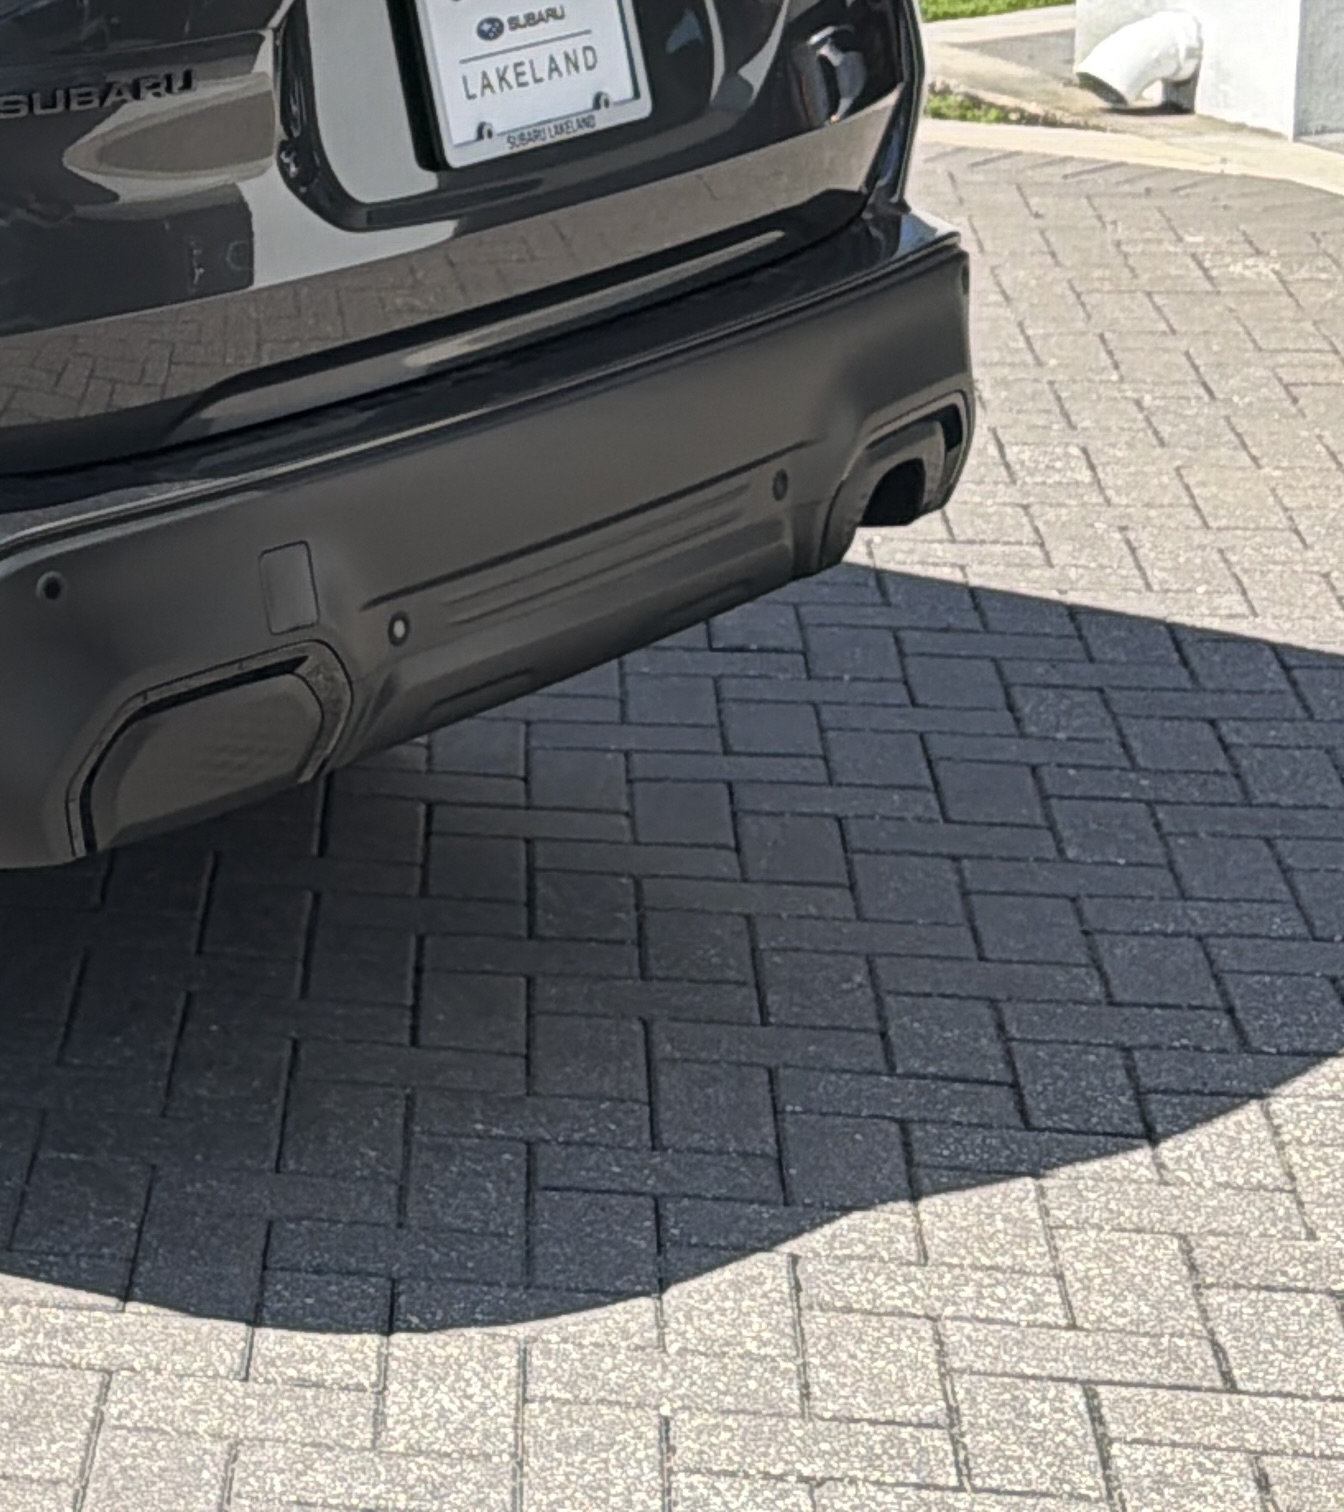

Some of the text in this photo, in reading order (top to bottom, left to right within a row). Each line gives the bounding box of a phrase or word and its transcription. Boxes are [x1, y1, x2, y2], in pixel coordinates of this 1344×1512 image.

[507, 6, 566, 31] SUBARU
[462, 45, 599, 100] LAKELAND
[506, 114, 597, 150] SUBARU LAKELAND
